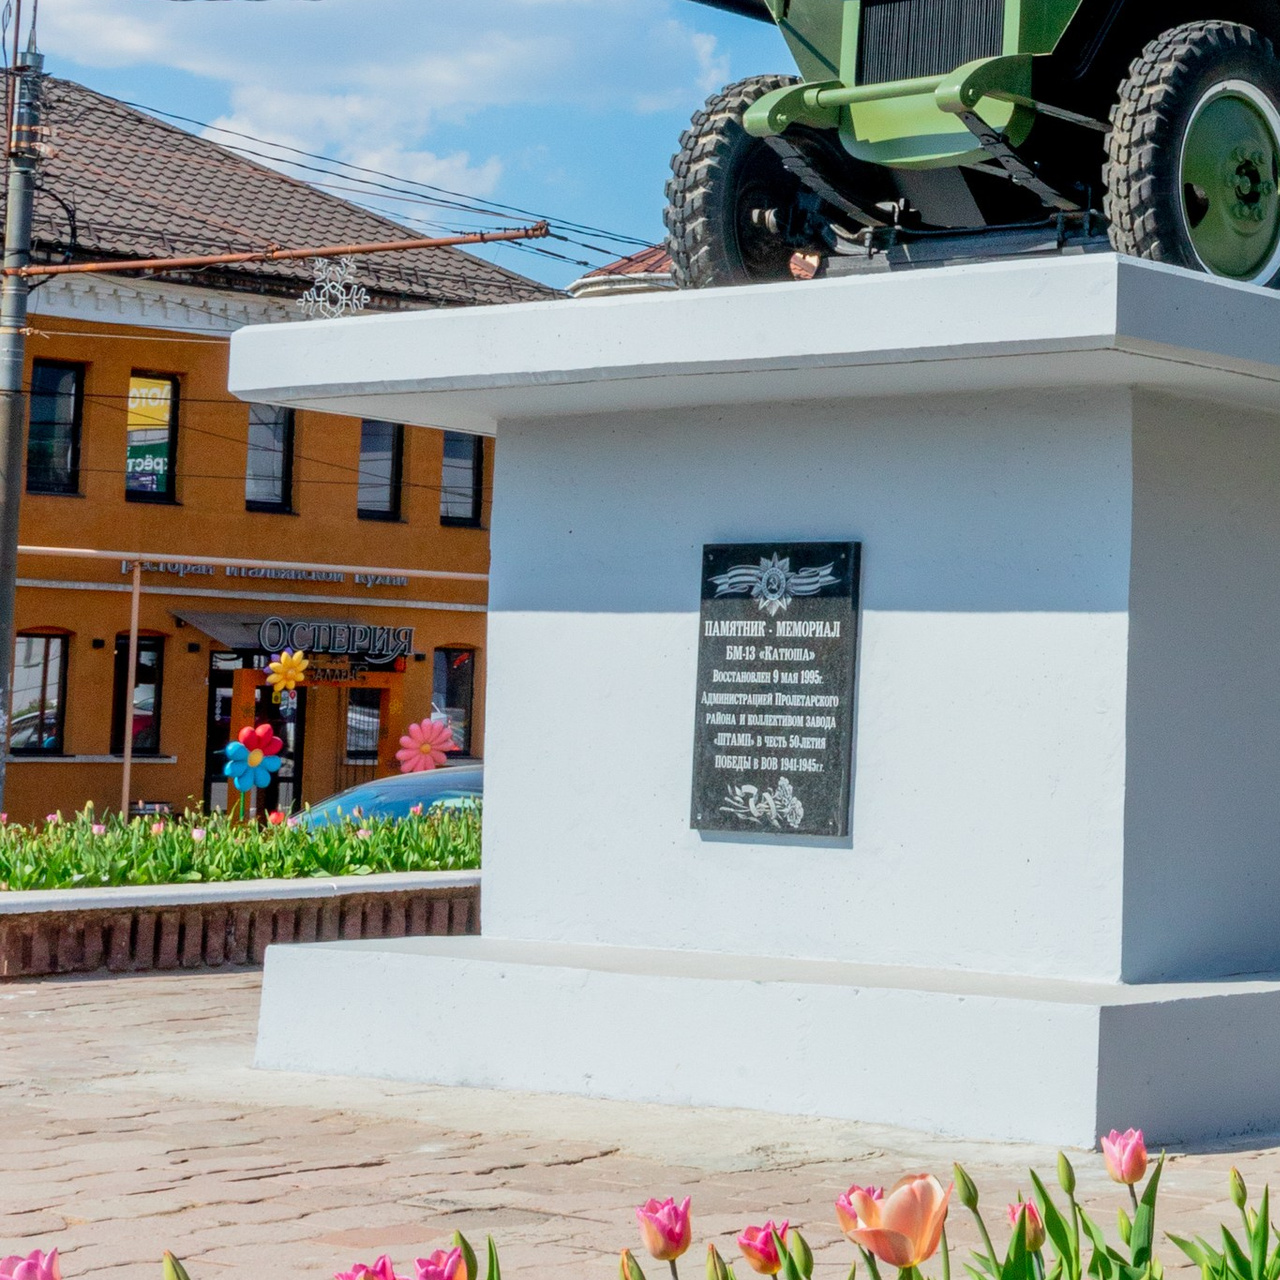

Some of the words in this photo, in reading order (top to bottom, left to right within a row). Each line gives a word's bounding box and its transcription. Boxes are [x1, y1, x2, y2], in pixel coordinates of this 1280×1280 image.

[704, 621, 766, 637] ПАМЯТНИК
[776, 621, 840, 637] МЕМОРИАЛ
[726, 645, 756, 660] БМ-13
[773, 669, 779, 683] 9
[715, 755, 751, 772] ПОБЕДЫ
[761, 757, 778, 770] ВОВ
